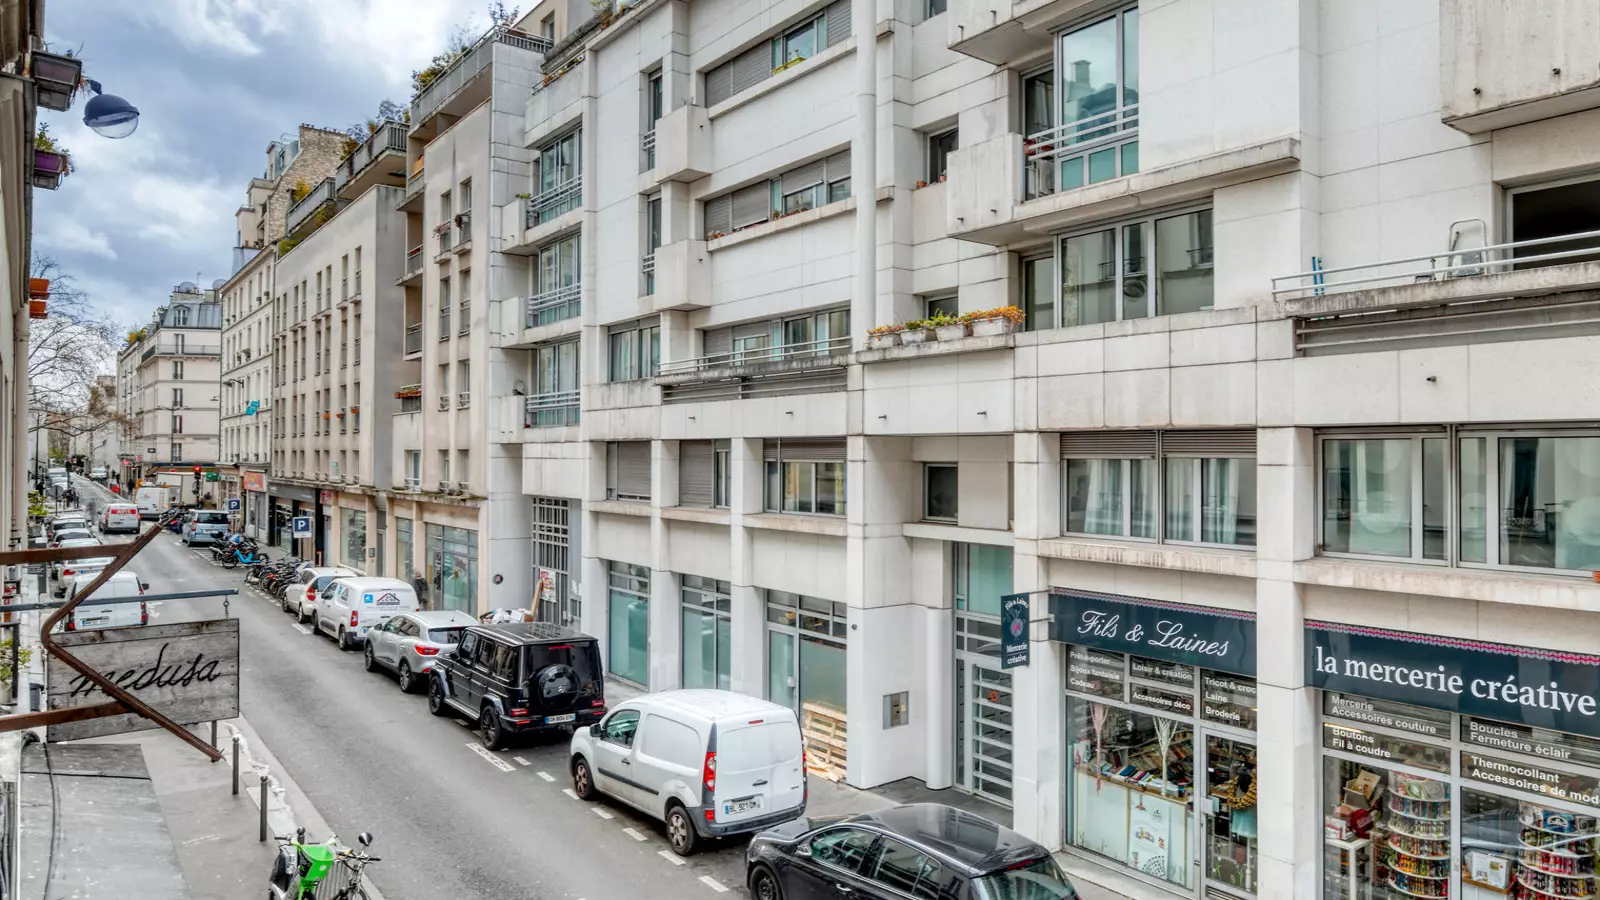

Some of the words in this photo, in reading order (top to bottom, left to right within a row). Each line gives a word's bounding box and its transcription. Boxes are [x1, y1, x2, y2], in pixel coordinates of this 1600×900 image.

[1077, 610, 1120, 639] Fils
[1125, 624, 1144, 642] &
[1147, 620, 1230, 657] Laines
[1070, 664, 1090, 675] Bijoux
[1091, 668, 1120, 680] fantaisie
[1132, 662, 1153, 673] Loisir
[1154, 667, 1161, 675] &
[1161, 668, 1193, 681] création
[1316, 646, 1338, 675] la
[1344, 658, 1463, 695] mercerie
[1470, 675, 1597, 716] créative
[1070, 677, 1095, 689] Cadeau
[1204, 676, 1228, 689] Tricot
[1229, 681, 1236, 690] &
[1132, 691, 1173, 706] Accessoires
[1173, 700, 1191, 710] déco
[1205, 691, 1228, 703] Laine
[1331, 695, 1374, 711] Mercerie
[1205, 706, 1240, 721] Broderie
[1331, 706, 1393, 726] Accessoires
[1395, 720, 1437, 734] couture
[1332, 727, 1374, 743] Boutons
[1469, 721, 1518, 739] Boucles
[1332, 738, 1345, 749] Fil
[1346, 740, 1354, 750] à
[1355, 745, 1391, 758] coudre
[1470, 732, 1532, 752] Fermeture
[1535, 744, 1571, 759] éclair
[1471, 755, 1560, 784] Thermocollant
[1471, 768, 1547, 793] Accessoires
[1550, 786, 1566, 797] de
